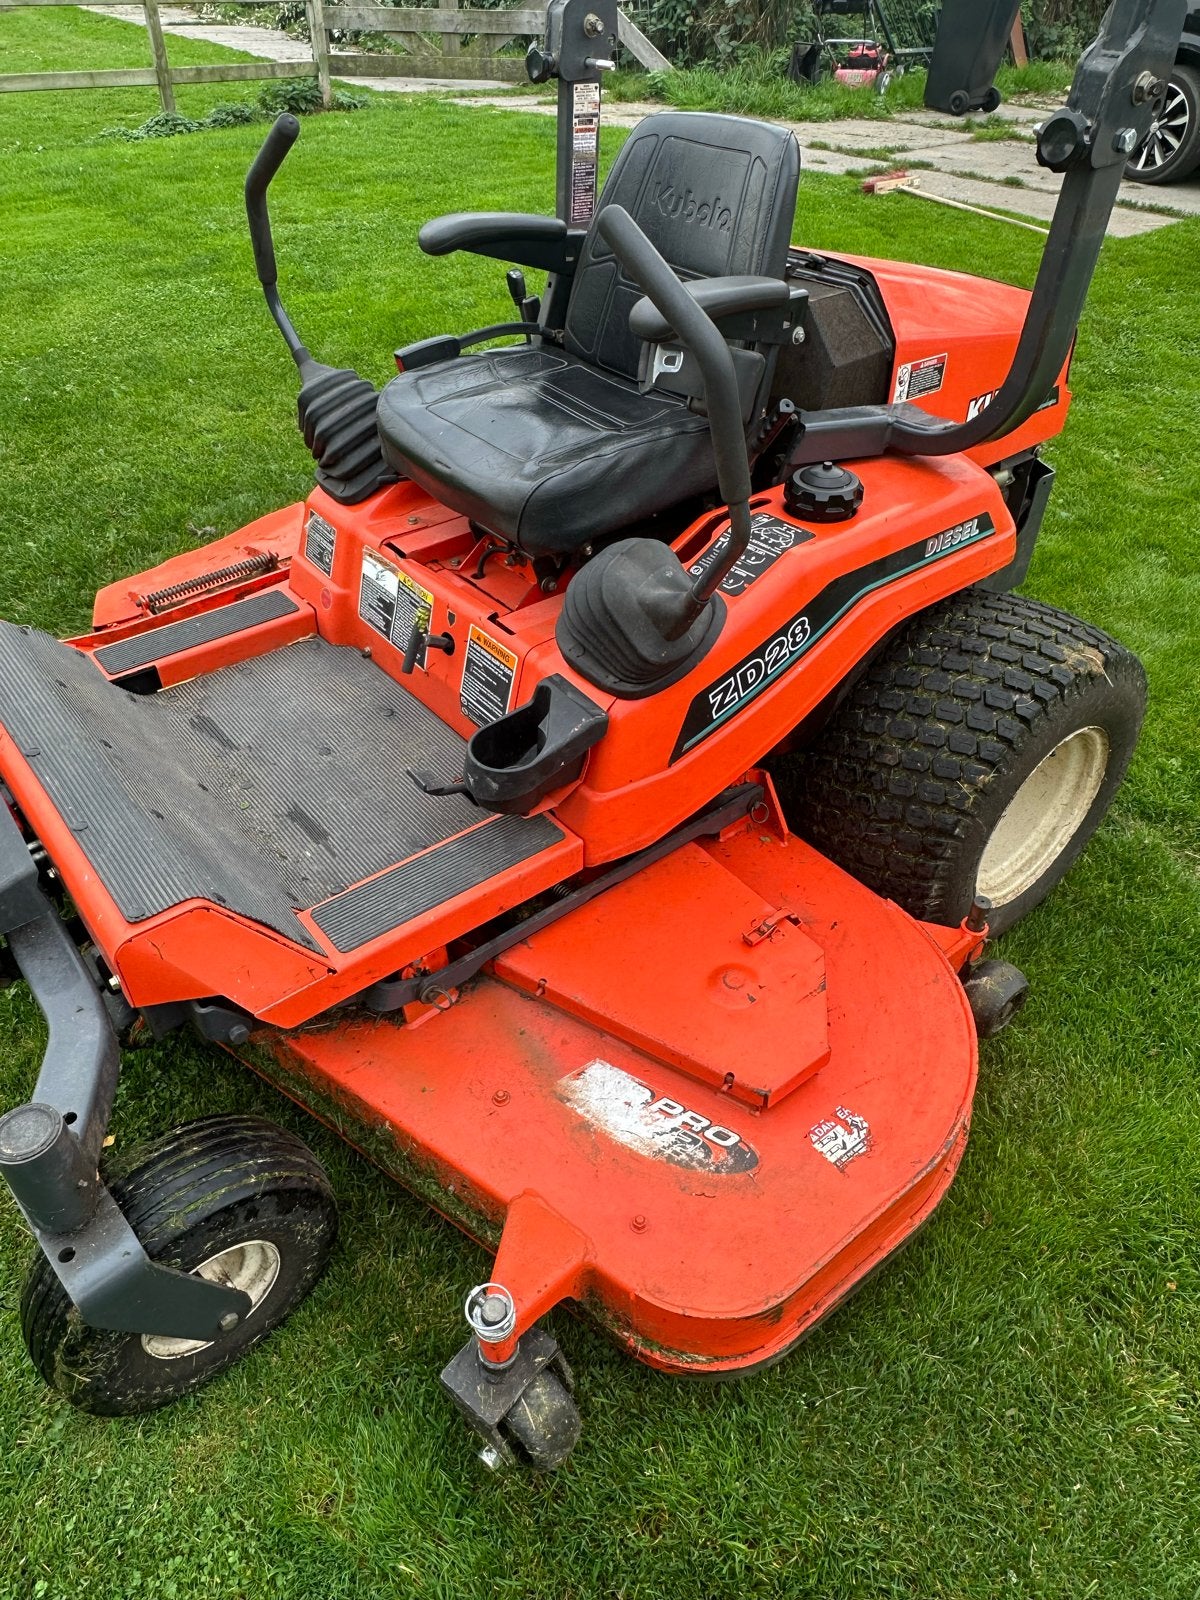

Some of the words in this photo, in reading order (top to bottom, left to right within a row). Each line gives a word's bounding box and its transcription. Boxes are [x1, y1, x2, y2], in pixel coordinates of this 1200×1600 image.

[651, 182, 731, 232] Kubota
[925, 519, 979, 558] DIESEL
[483, 638, 510, 663] WARNING
[709, 617, 810, 719] ZD28
[649, 1097, 742, 1147] PRO
